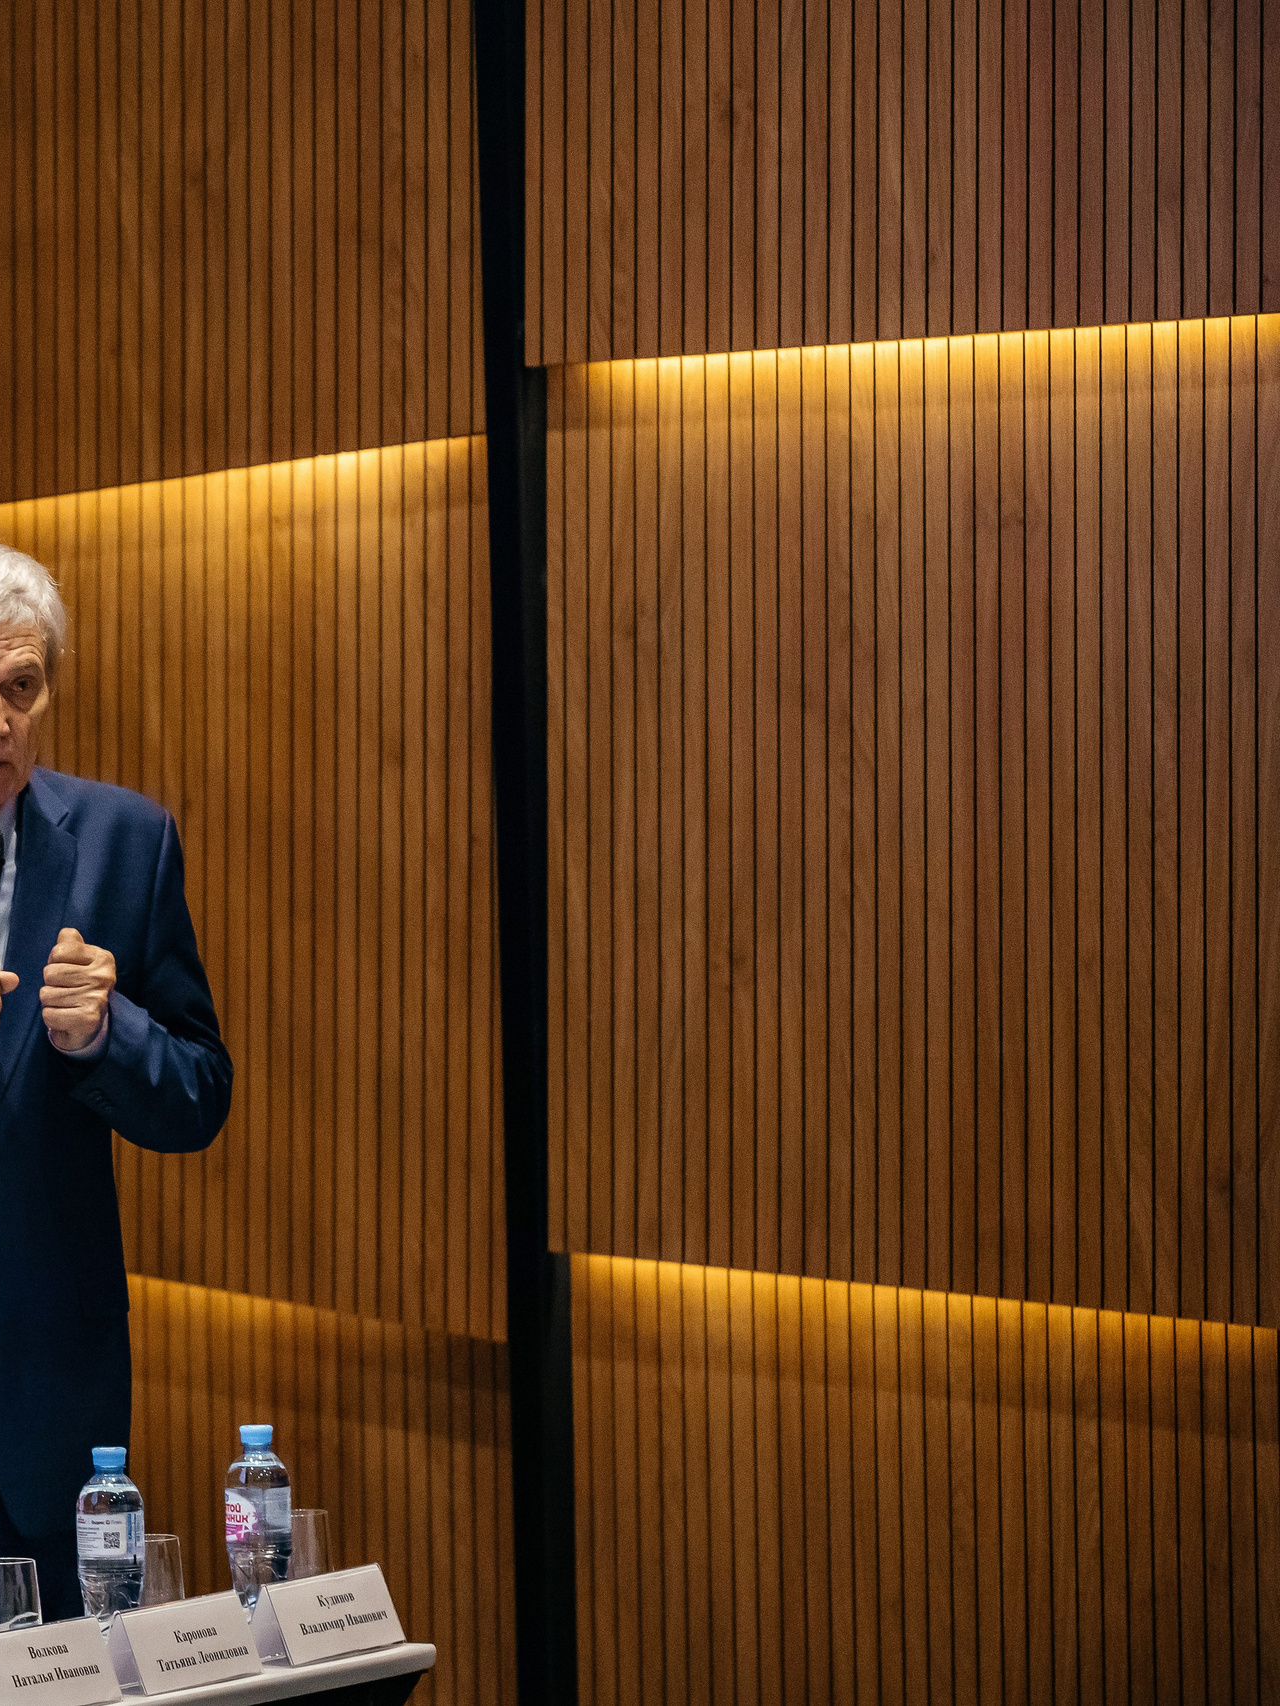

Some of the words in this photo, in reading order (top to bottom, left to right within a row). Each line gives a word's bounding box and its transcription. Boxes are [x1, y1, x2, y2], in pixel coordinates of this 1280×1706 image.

[225, 1503, 241, 1513] ТОЙ
[316, 1592, 355, 1609] Кудинов
[299, 1618, 345, 1636] Владимир
[345, 1610, 388, 1626] Иванович
[173, 1626, 218, 1644] Каронова
[27, 1644, 69, 1659] Волкова
[156, 1656, 197, 1672] Татьяна
[198, 1645, 249, 1665] Леонидовна
[11, 1671, 55, 1688] Наталья
[54, 1664, 100, 1681] Ивановна
